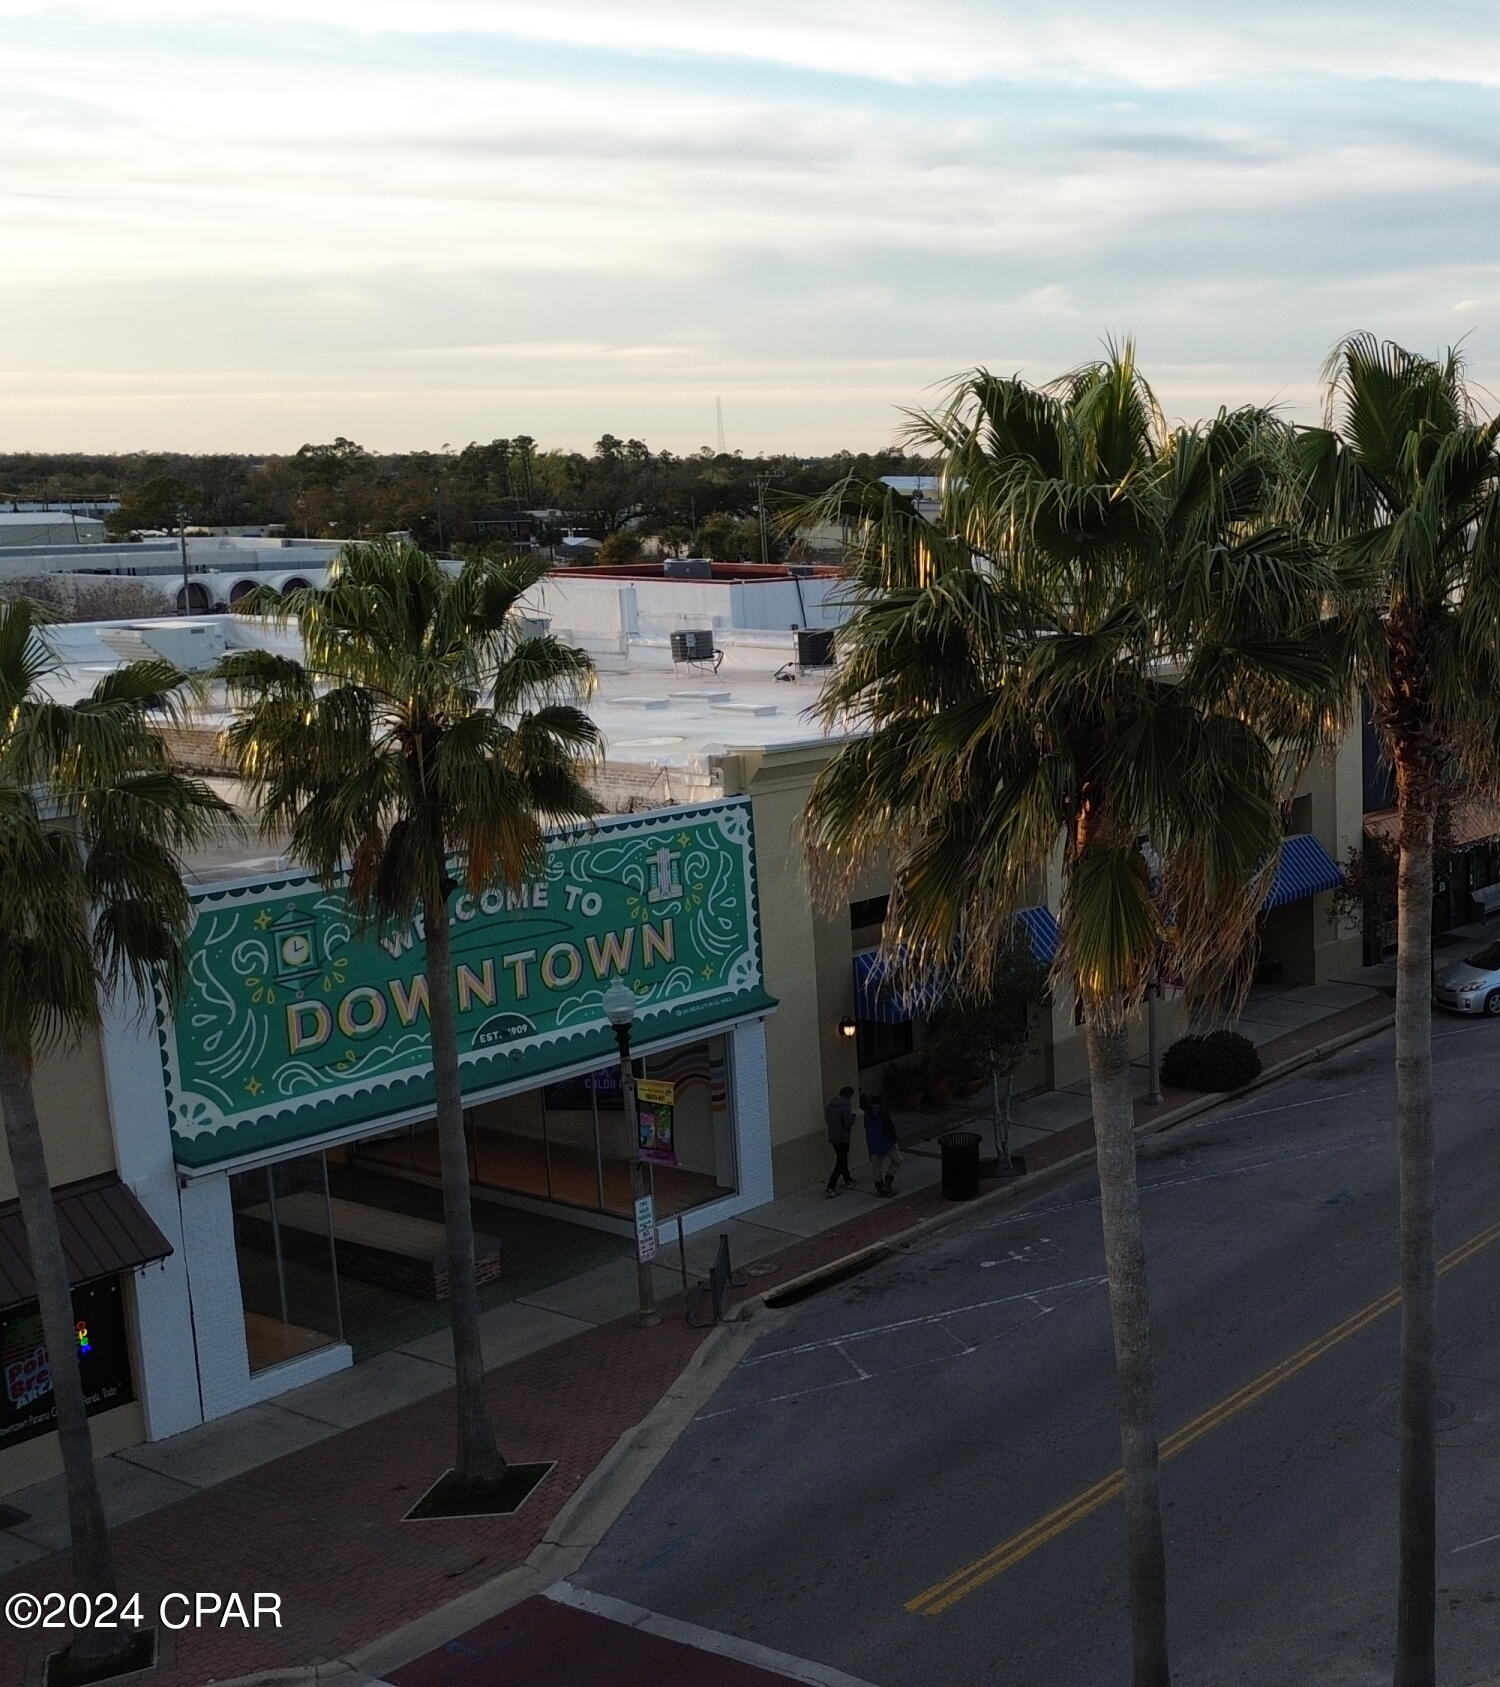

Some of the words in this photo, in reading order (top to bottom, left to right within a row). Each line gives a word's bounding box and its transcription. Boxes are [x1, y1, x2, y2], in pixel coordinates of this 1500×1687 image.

[564, 884, 603, 917] TO
[285, 917, 677, 1056] DOWNTOWN
[480, 1031, 502, 1043] EST.
